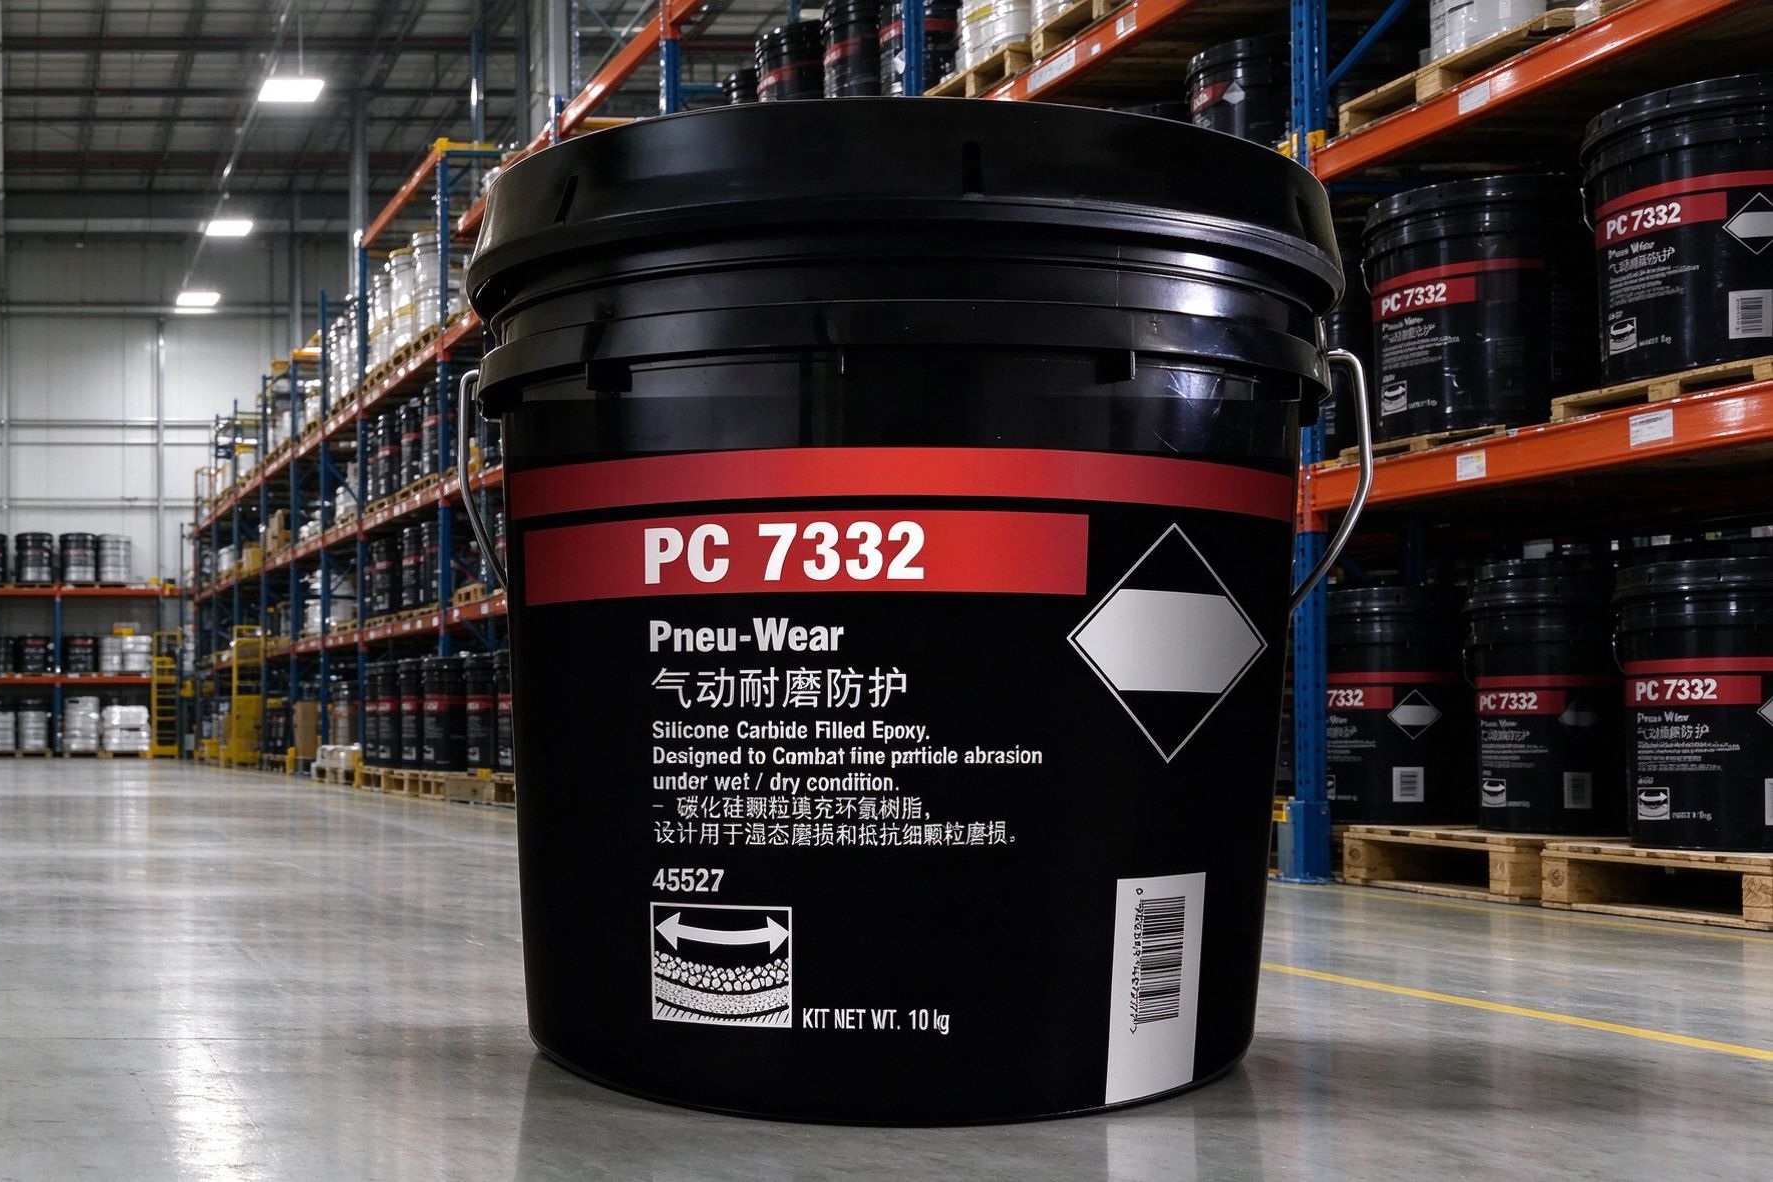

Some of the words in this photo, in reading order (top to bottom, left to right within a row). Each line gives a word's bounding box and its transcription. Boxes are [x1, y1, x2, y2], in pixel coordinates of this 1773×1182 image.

[1607, 215, 1627, 239] PC
[1631, 202, 1681, 231] 7332
[1382, 293, 1401, 315] PC
[1404, 283, 1446, 306] 7332
[645, 524, 729, 584] PC
[759, 521, 924, 580] 7332
[650, 618, 844, 652] Pneu-Wear
[652, 667, 906, 708] 气动耐磨防护
[1327, 689, 1364, 706] 7332
[1636, 681, 1659, 701] PC
[1664, 678, 1717, 700] 7332
[1480, 694, 1496, 711] PC
[1499, 692, 1538, 709] 7332
[653, 721, 729, 739] Silicone
[737, 721, 807, 739] Carbide
[816, 721, 864, 739] Filled
[873, 721, 929, 744] Epoxy.
[654, 747, 741, 768] Designed
[748, 748, 766, 764] to
[773, 747, 845, 764] Combat
[964, 745, 1042, 763] abrasion
[653, 772, 708, 789] under
[714, 773, 750, 790] wet
[755, 773, 763, 790] /
[770, 773, 800, 794] dry
[653, 868, 724, 892] 45527
[803, 1008, 830, 1028] KIT
[835, 1009, 866, 1029] NET
[871, 1009, 900, 1029] WT.
[909, 1009, 928, 1030] 10
